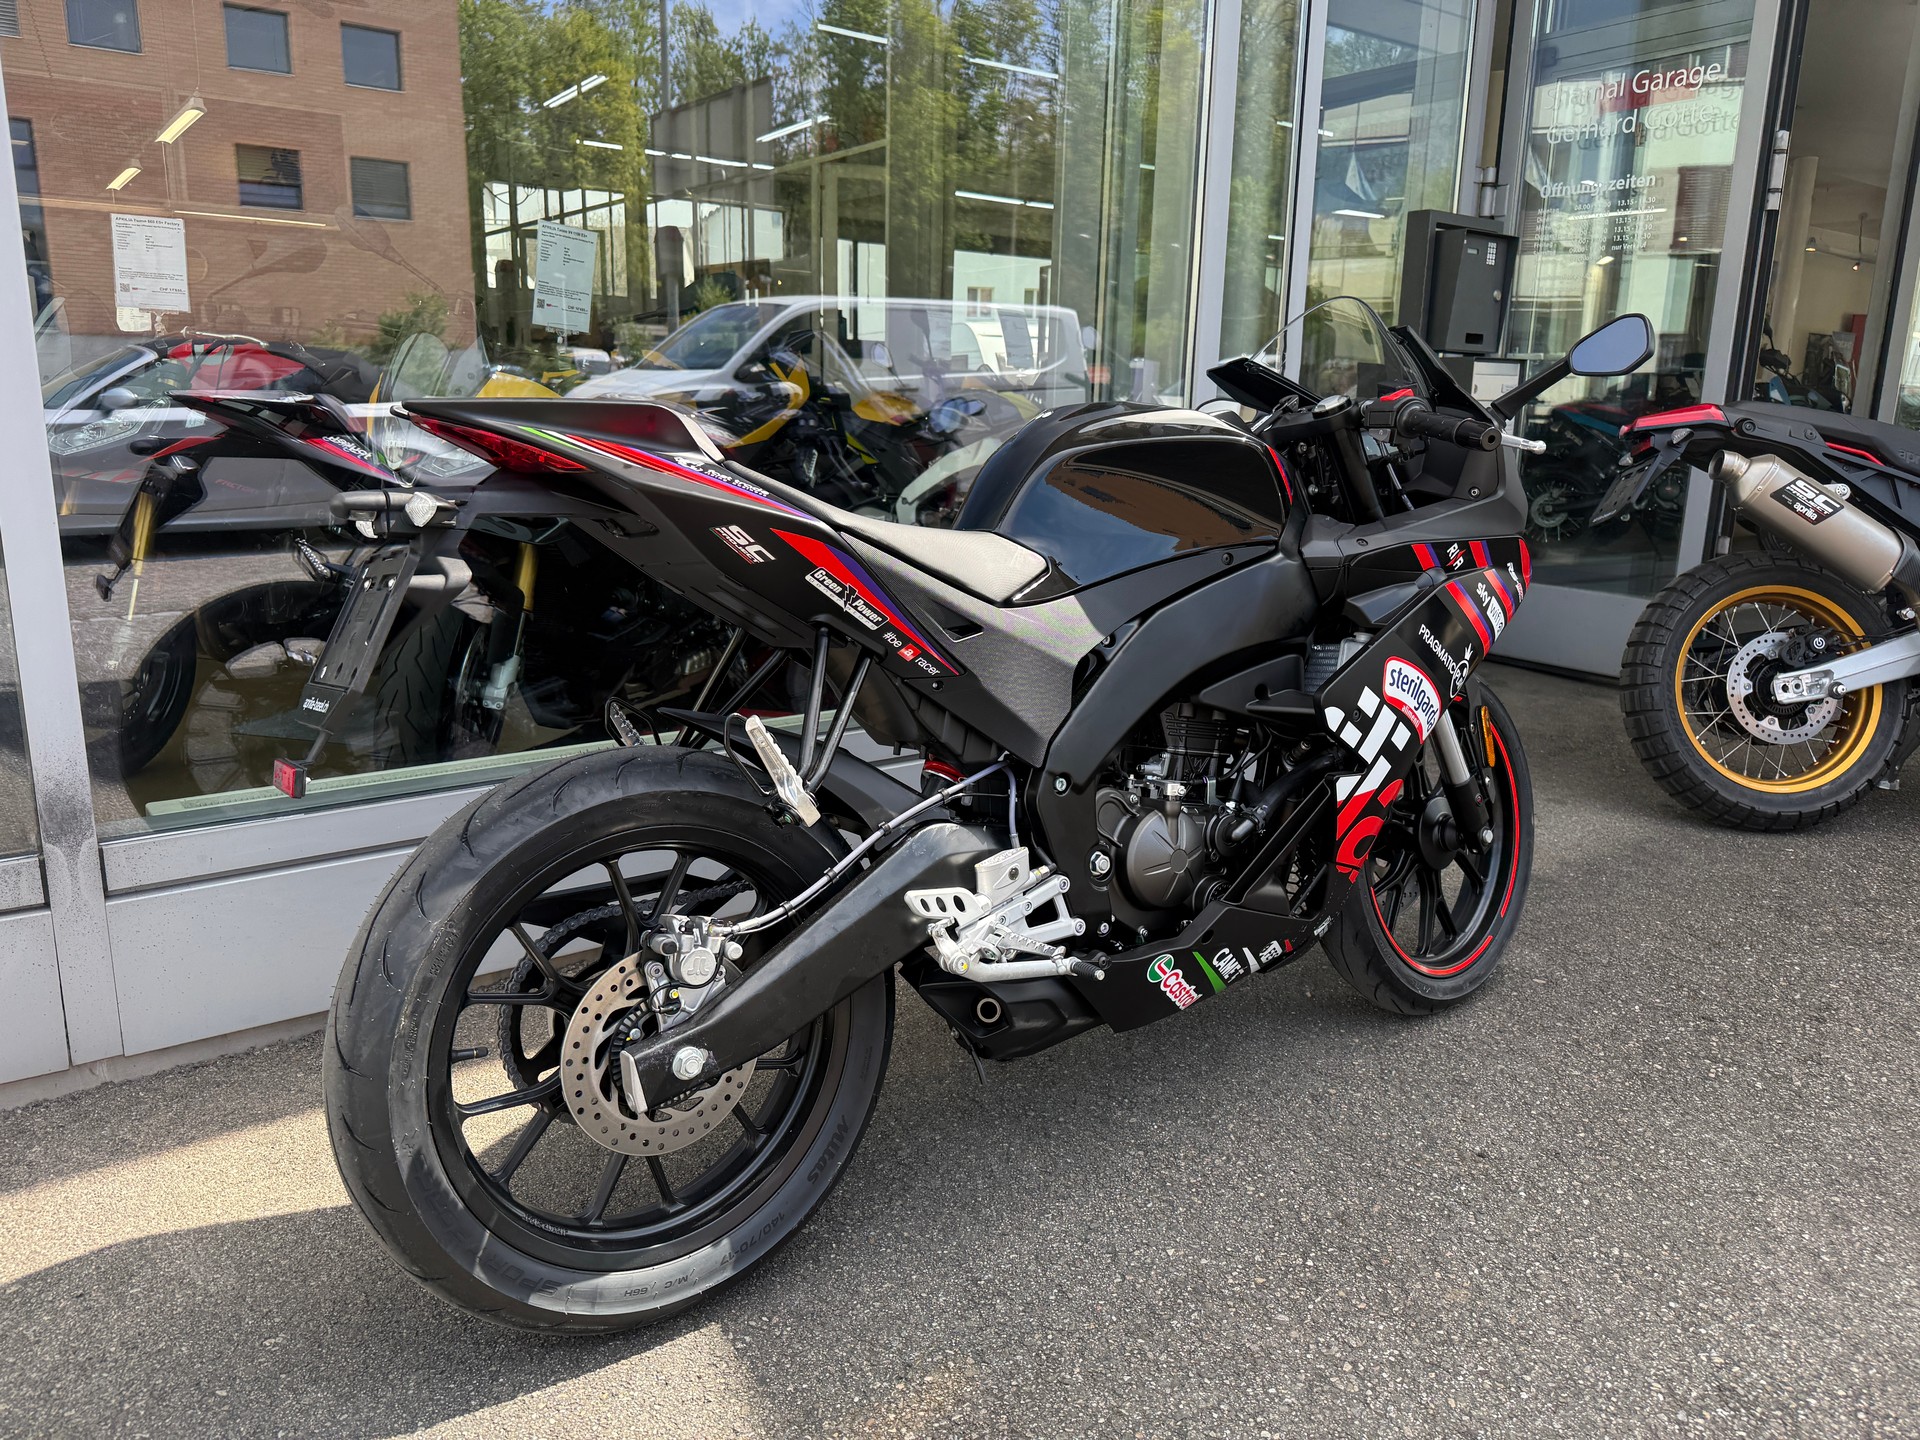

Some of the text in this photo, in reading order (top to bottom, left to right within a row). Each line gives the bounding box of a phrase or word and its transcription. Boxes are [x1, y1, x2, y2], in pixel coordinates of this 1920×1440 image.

[1632, 62, 1721, 94] Garage
[1546, 108, 1638, 144] Gerhard
[1613, 234, 1629, 242] 13.15
[1786, 486, 1830, 515] PROJECT
[1790, 480, 1840, 513] SC
[1793, 502, 1817, 520] aprilia
[715, 527, 760, 563] PROJECT
[720, 525, 776, 563] SC
[813, 569, 882, 623] Green Power
[1476, 582, 1491, 607] sky
[882, 631, 902, 648] #be
[915, 656, 941, 676] racer
[1418, 624, 1456, 675] PRAGMATIC
[1389, 668, 1439, 733] sterilgarda
[1401, 704, 1421, 727] alimenti
[1163, 972, 1197, 1008] Castro
[806, 1114, 850, 1185] Mitas
[624, 1212, 785, 1298] 140/70-17 M/C 66H
